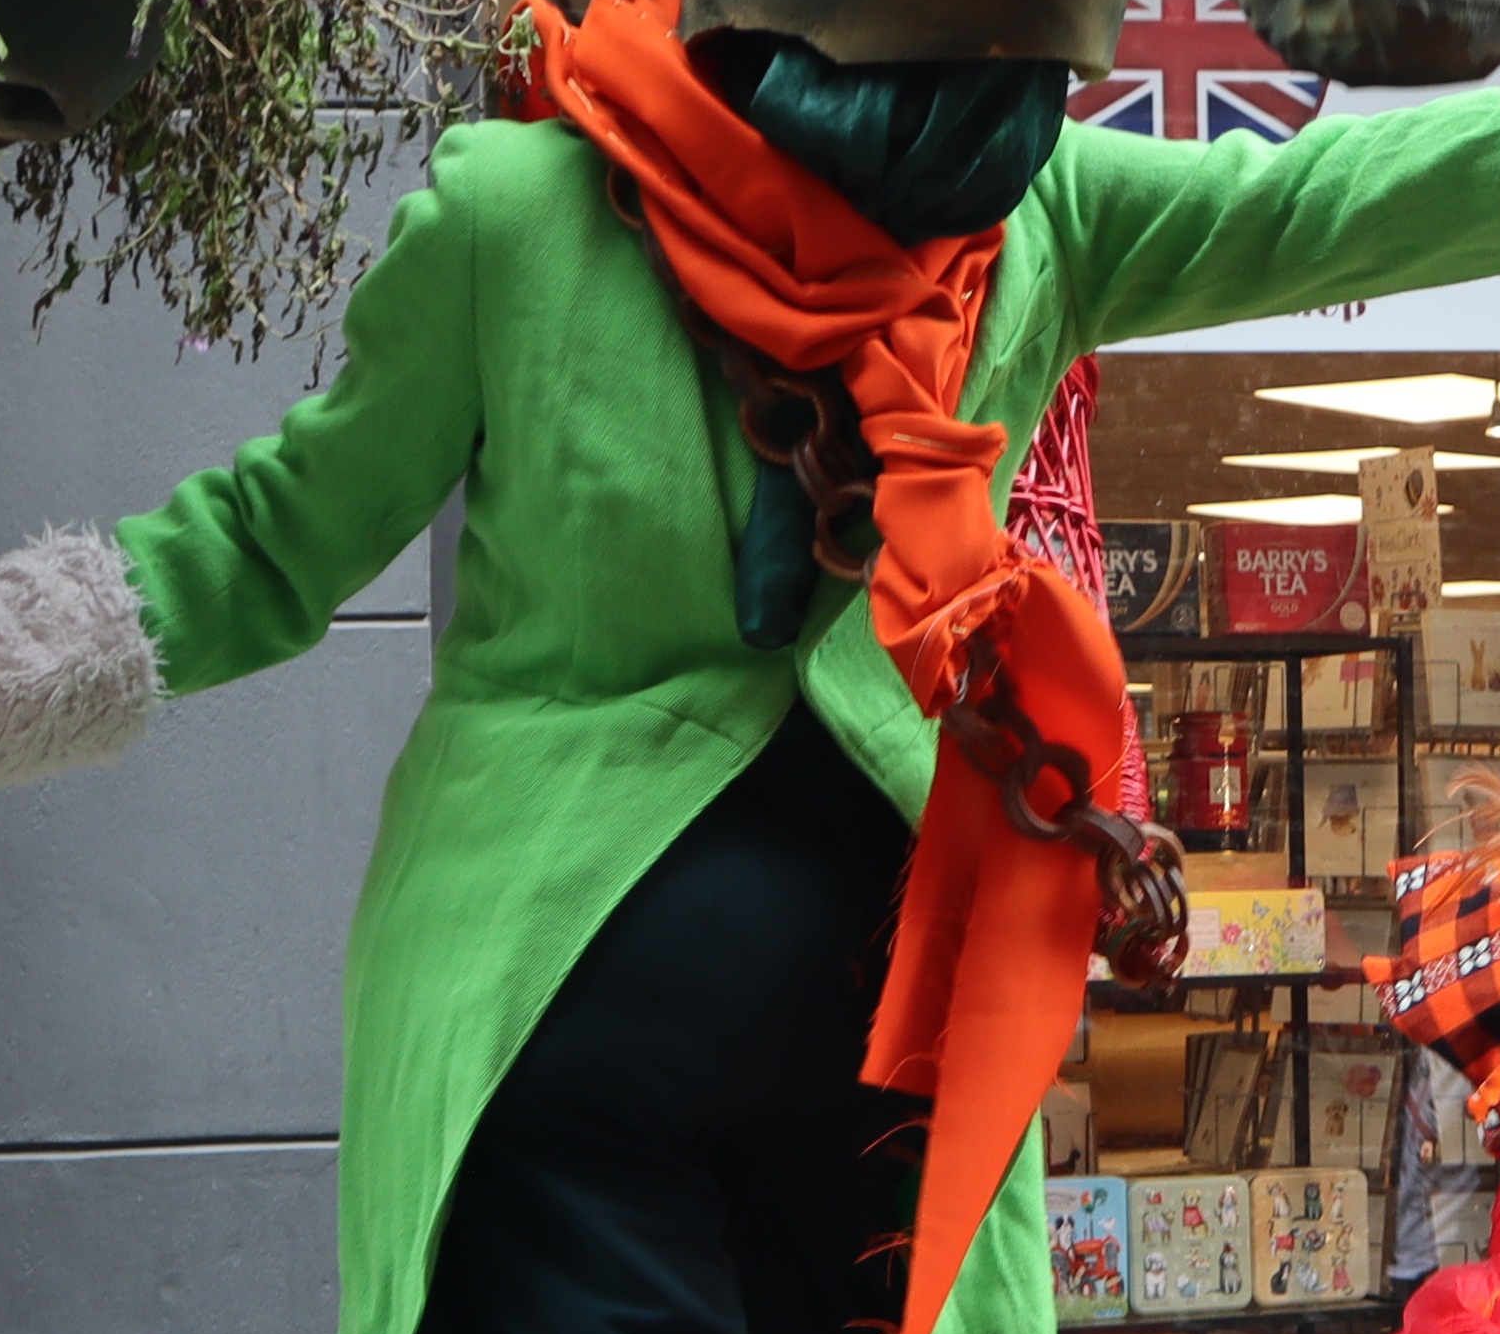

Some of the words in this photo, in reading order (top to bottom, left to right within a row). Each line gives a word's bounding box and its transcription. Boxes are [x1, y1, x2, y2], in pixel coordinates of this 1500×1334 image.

[1100, 549, 1158, 573] RRY'S
[1236, 549, 1328, 573] BARRY'S
[1105, 572, 1136, 596] EA
[1259, 571, 1307, 596] TEA
